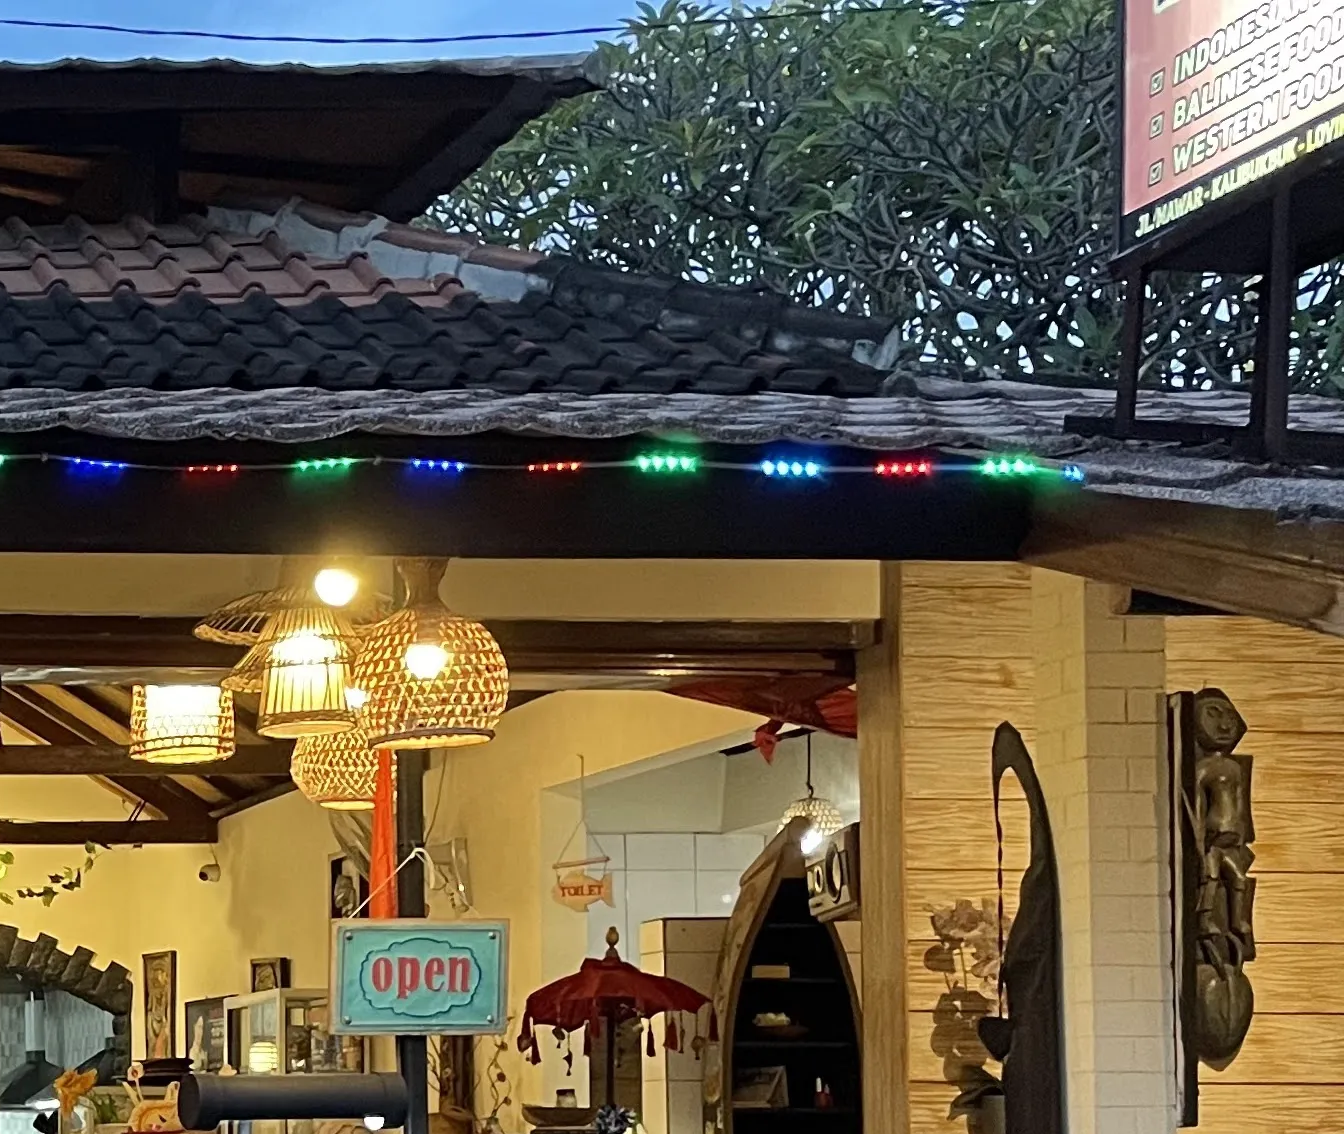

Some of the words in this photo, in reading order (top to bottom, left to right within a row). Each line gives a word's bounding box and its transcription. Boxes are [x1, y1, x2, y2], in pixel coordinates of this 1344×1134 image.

[1171, 42, 1280, 133] BALINESE
[1282, 6, 1344, 72] FOOD
[1172, 90, 1280, 176] WESTERN
[1281, 55, 1344, 120] FOOD
[560, 884, 604, 897] TOILET
[371, 956, 471, 999] open
